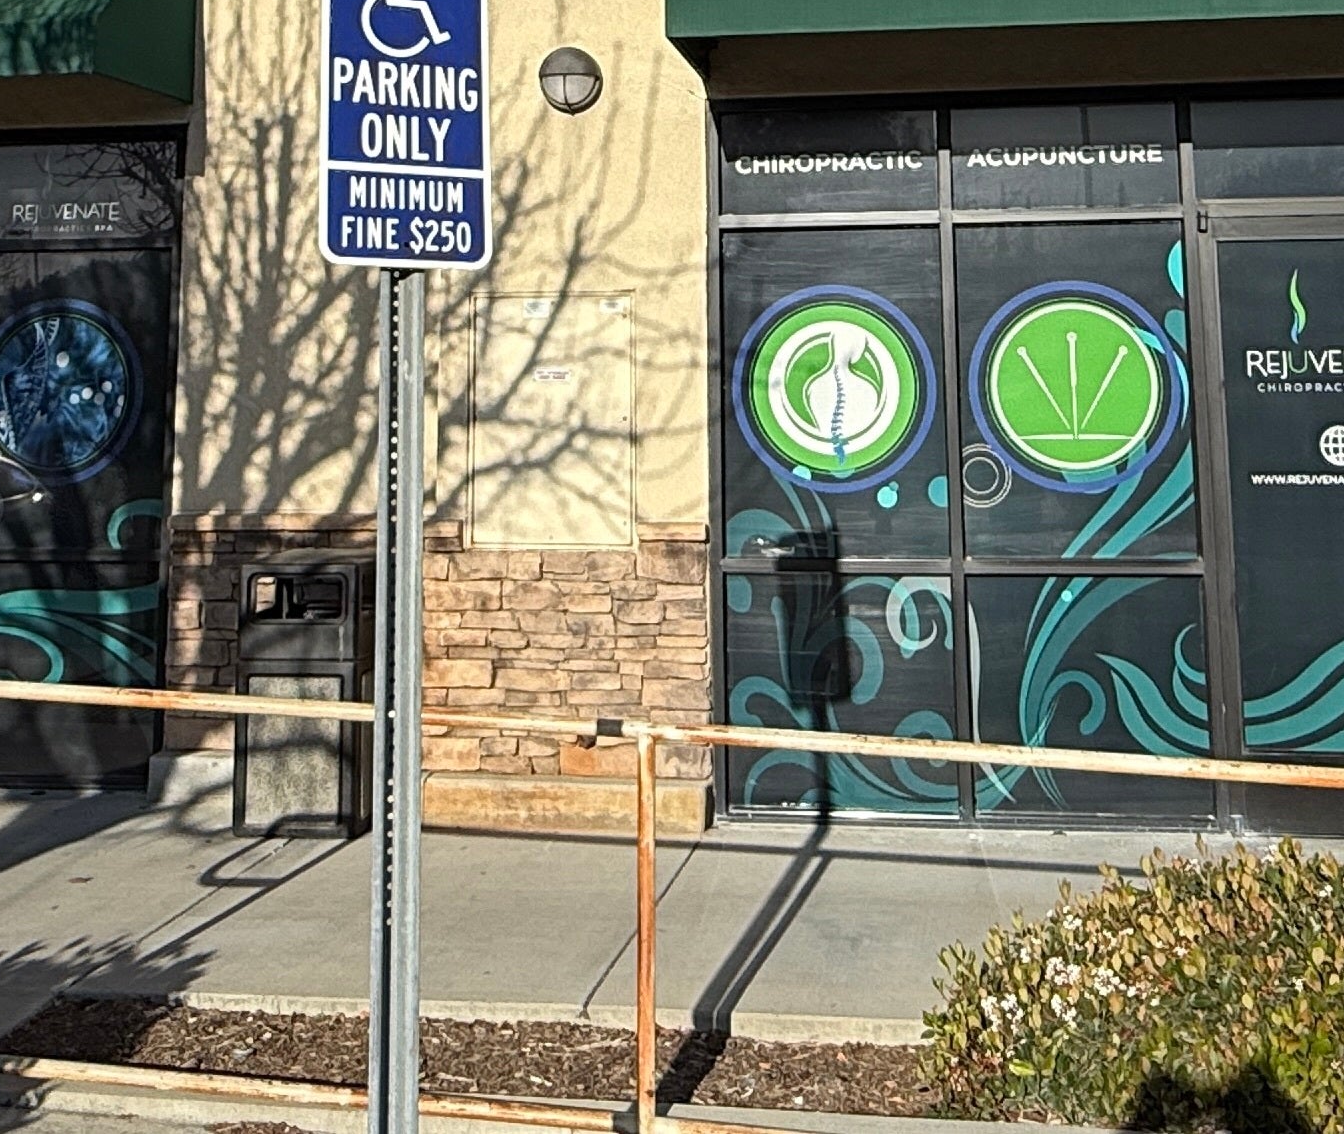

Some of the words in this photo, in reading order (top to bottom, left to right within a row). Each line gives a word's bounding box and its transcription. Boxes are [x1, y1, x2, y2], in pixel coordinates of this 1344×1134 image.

[332, 56, 479, 113] PARKING
[360, 112, 452, 163] ONLY
[966, 143, 1164, 167] ACUPUNCTURE
[734, 150, 924, 175] CHIROPRACTIC
[12, 201, 121, 225] REJUVENATE
[349, 175, 464, 214] MINIMUM
[340, 216, 400, 251] FINE
[409, 216, 472, 255] $250
